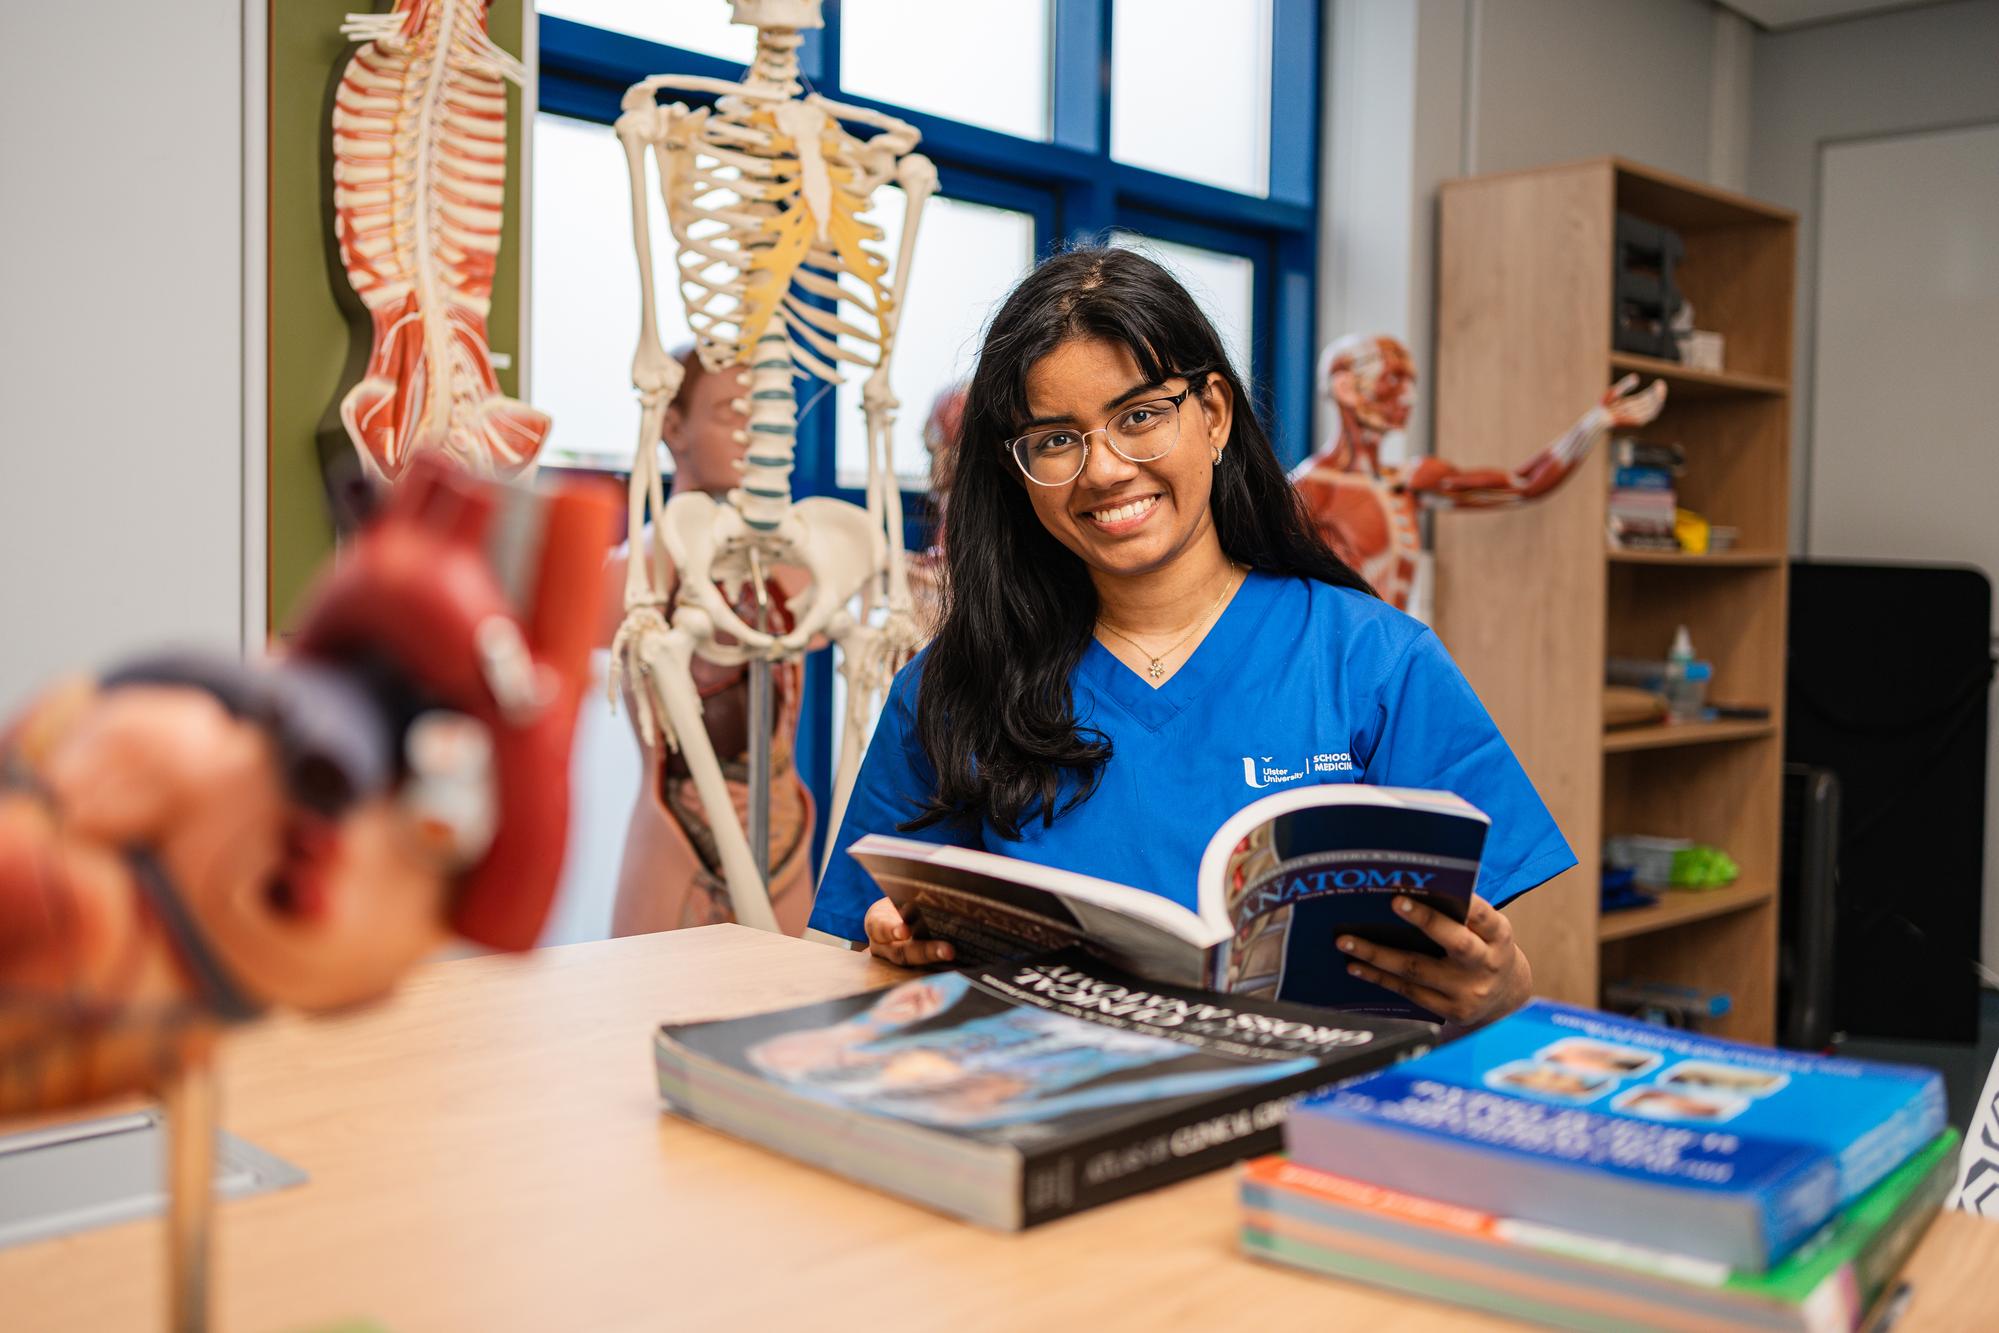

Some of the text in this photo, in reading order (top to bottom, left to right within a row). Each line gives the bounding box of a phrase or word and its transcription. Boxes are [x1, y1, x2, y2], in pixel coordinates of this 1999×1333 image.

[1312, 752, 1351, 763] SCHOOL
[1263, 767, 1288, 776] Ulster
[1263, 771, 1304, 783] University
[1239, 867, 1436, 920] ANATOMY
